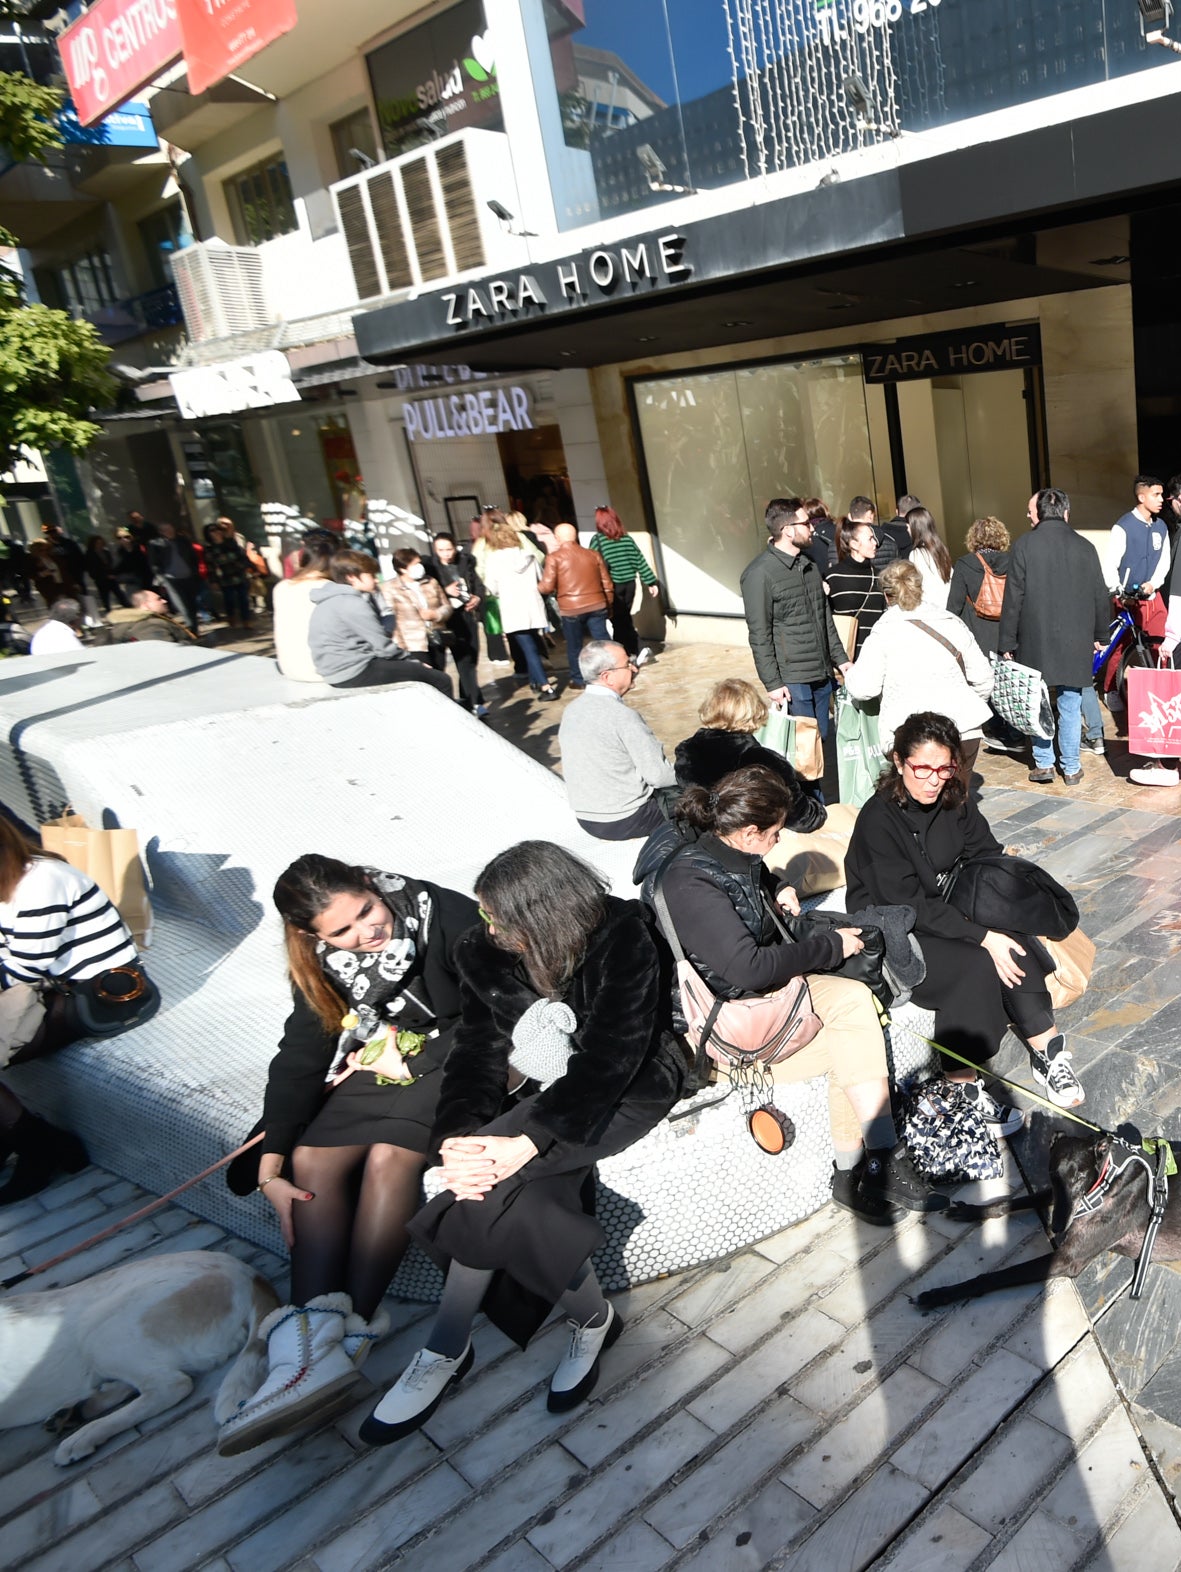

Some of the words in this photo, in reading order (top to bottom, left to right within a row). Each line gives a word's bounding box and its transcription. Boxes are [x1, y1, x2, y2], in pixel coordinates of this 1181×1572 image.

[441, 275, 541, 325] ZARA
[556, 234, 688, 298] HOME
[866, 349, 939, 377] ZARA
[949, 336, 1031, 367] HOME
[402, 387, 533, 440] PULL&BEAR
